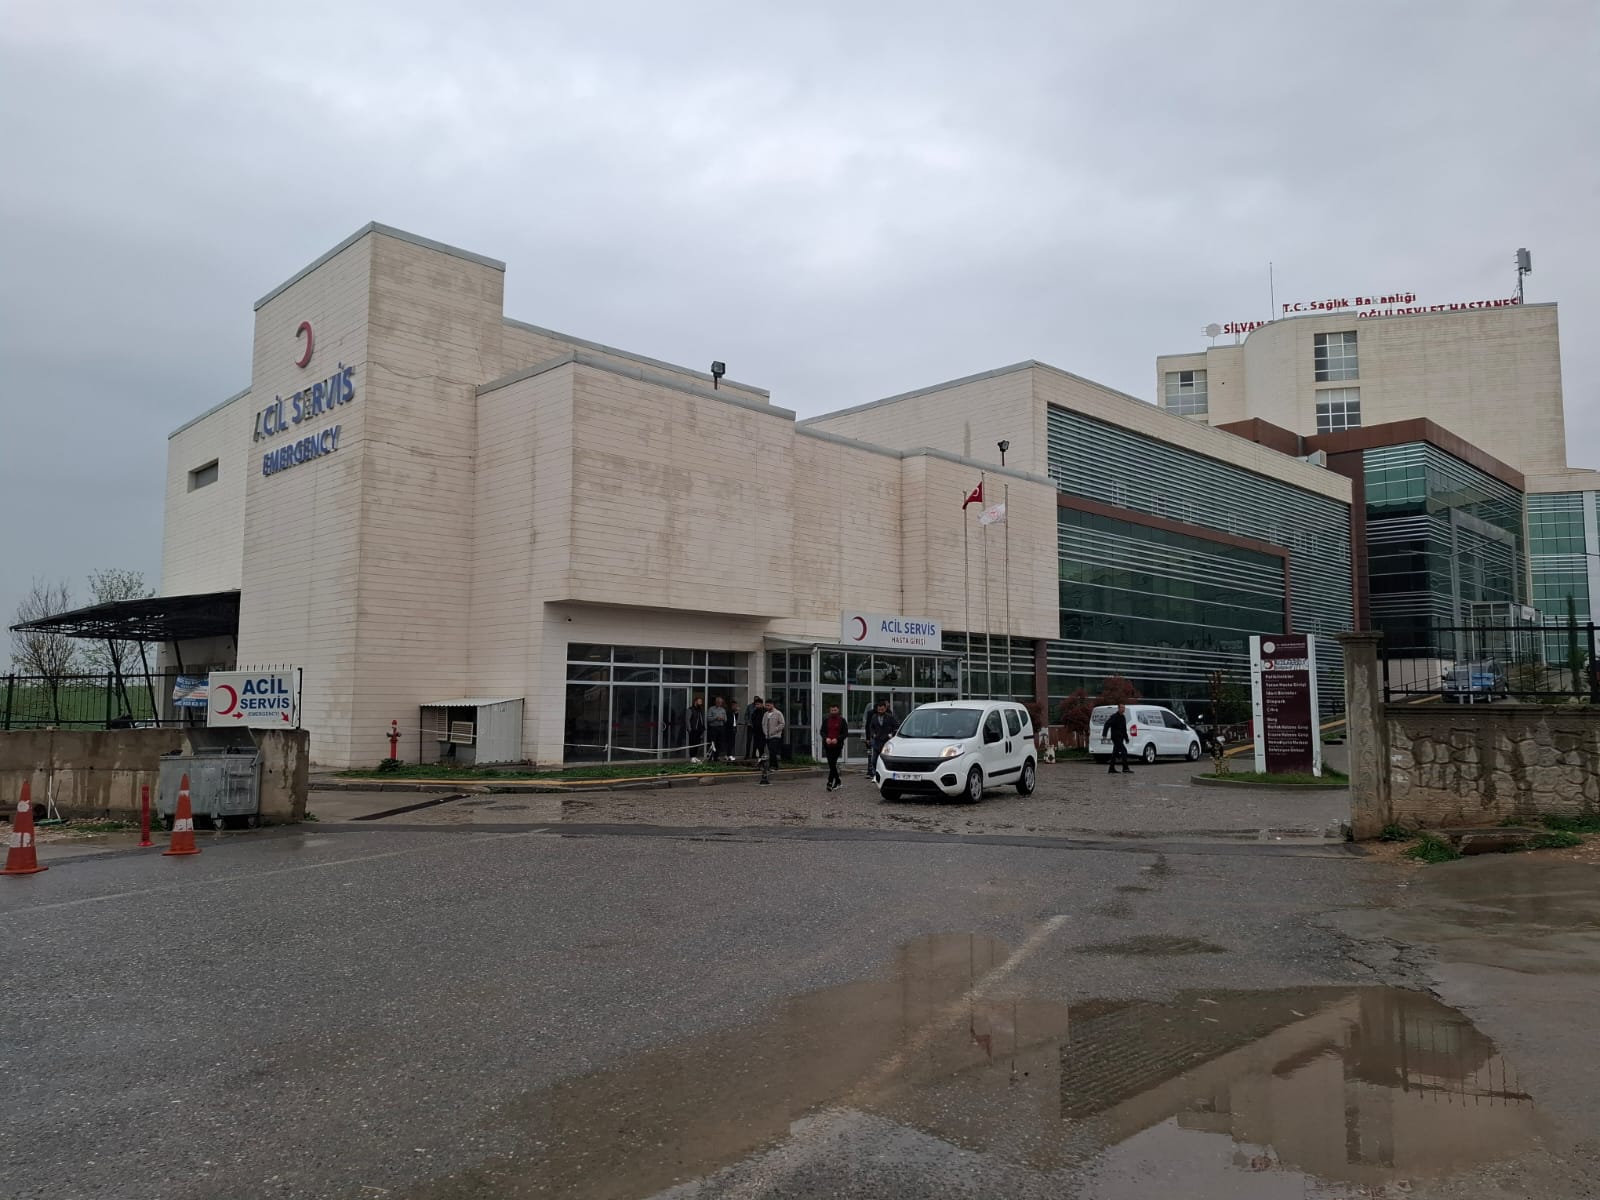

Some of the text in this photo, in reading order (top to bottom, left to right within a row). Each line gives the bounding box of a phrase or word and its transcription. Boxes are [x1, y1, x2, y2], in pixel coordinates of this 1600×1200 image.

[1283, 292, 1416, 313] T.C. Sağlık Bakanlığı
[292, 362, 354, 424] SERVİS
[263, 425, 341, 477] EMERGENCY
[881, 619, 936, 636] ACİL SERVİS
[242, 675, 288, 695] ACİL
[240, 695, 290, 709] SERVİS
